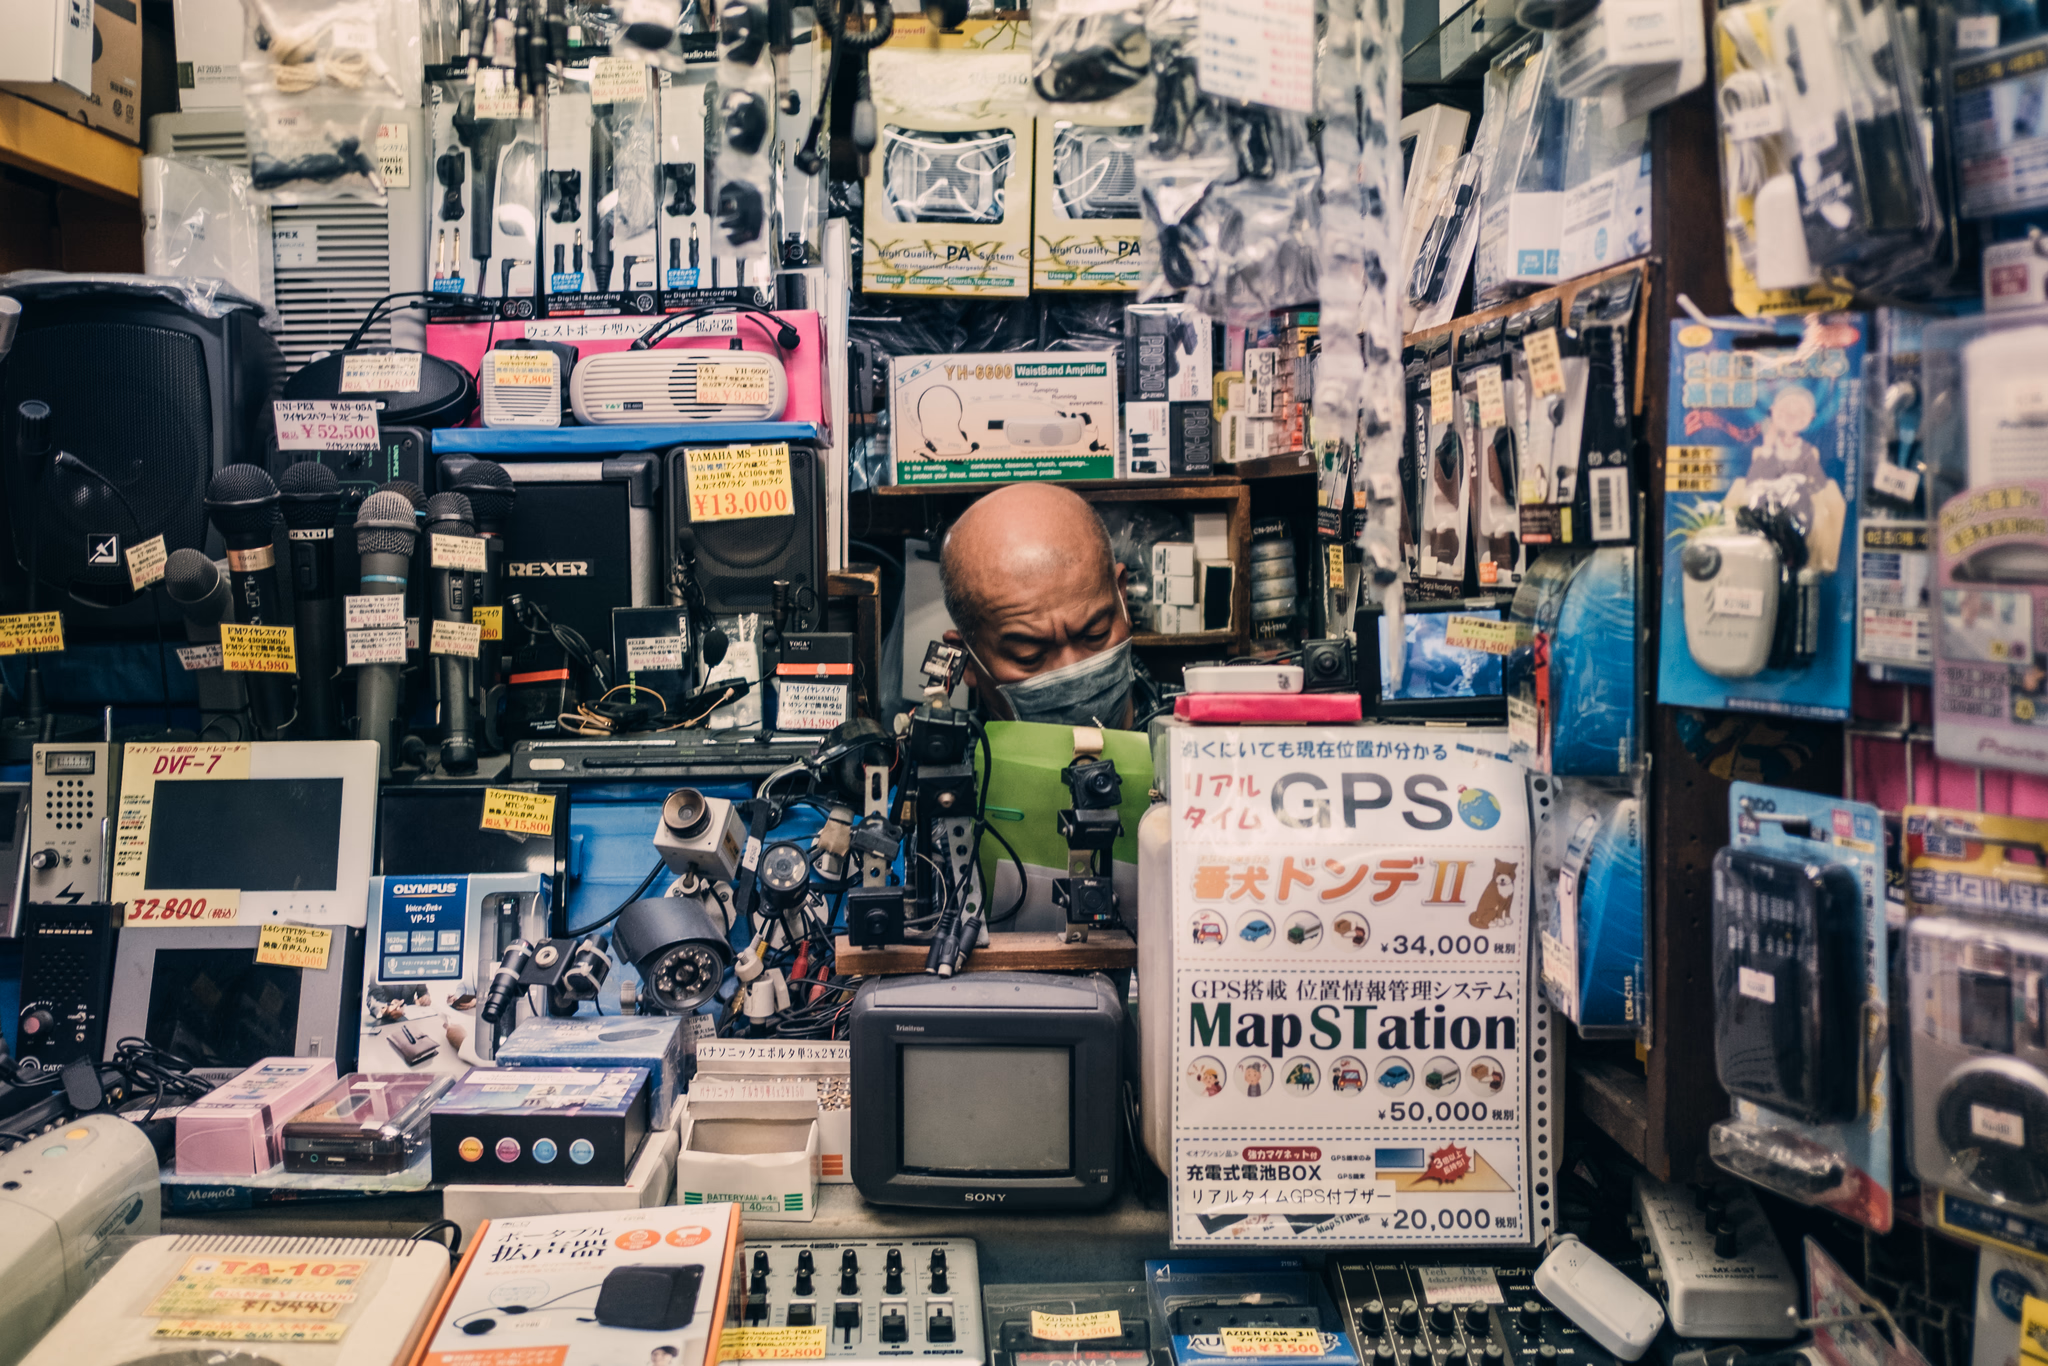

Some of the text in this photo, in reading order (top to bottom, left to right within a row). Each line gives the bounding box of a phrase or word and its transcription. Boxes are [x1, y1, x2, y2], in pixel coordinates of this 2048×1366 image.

[197, 65, 223, 74] AT2035
[878, 245, 1015, 261] High Quality PA System
[1118, 240, 1142, 256] PA
[557, 293, 583, 303] Digital
[584, 292, 621, 301] Recording
[673, 289, 738, 300] Digital Recording
[1016, 363, 1106, 377] WaistBand Amplifier
[1139, 334, 1166, 392] PRO-XD
[513, 374, 551, 385] ¥7,800
[944, 363, 1014, 382] YH-6600
[365, 378, 417, 389] ¥19,800
[722, 390, 769, 404] ¥9,800
[275, 402, 374, 412] UNI-PEX WAS-05A
[301, 424, 376, 441] ¥52,500
[1184, 408, 1210, 463] PRO-XD
[1414, 403, 1428, 480] AT9920
[689, 450, 733, 462] YAMAHA
[1039, 469, 1063, 477] problem
[693, 488, 788, 517] ¥13,000
[1253, 524, 1284, 536] CN-204A
[508, 561, 589, 577] REXER
[17, 634, 60, 647] ¥14,000
[248, 658, 289, 672] ¥4,980
[802, 717, 840, 729] ¥4,980
[152, 754, 222, 775] DVF-7
[1184, 773, 1262, 798] リアル
[504, 800, 536, 811] MTC-700
[1271, 771, 1454, 831] GPS
[503, 815, 551, 833] ¥15,800
[1183, 805, 1262, 830] タイム
[1628, 807, 1638, 849] SONY
[392, 883, 459, 895] OLYMPUS
[128, 898, 238, 920] 32,800 (税込)
[410, 914, 436, 924] VP-15
[282, 935, 307, 944] CR-560
[1381, 935, 1517, 957] ¥34,000 税別
[280, 952, 324, 967] ¥28,000
[1191, 978, 1514, 1002] GPS搭載 位置情報管理システム
[895, 1024, 926, 1033] Trinitron
[1190, 1001, 1516, 1058] MapSTation
[1378, 1101, 1515, 1123] ¥50,000 税別
[1186, 1164, 1322, 1182] 充電式電池BOX
[186, 1187, 236, 1201] MemoQ
[964, 1192, 1007, 1202] SONY
[1192, 1187, 1392, 1206] リアルタイムGPS付ブザー
[1380, 1208, 1491, 1231] ¥20,000
[1495, 1216, 1518, 1229] 税別
[497, 1226, 613, 1243] ポータブル
[490, 1238, 611, 1264] 拡声器
[221, 1260, 363, 1278] TA-102
[1422, 1267, 1448, 1276] Tech
[1076, 1313, 1111, 1323] CAM-3
[1064, 1325, 1116, 1337] ¥3,500
[757, 1347, 824, 1358] ¥12,800
[1258, 1343, 1319, 1354] ¥3,500
